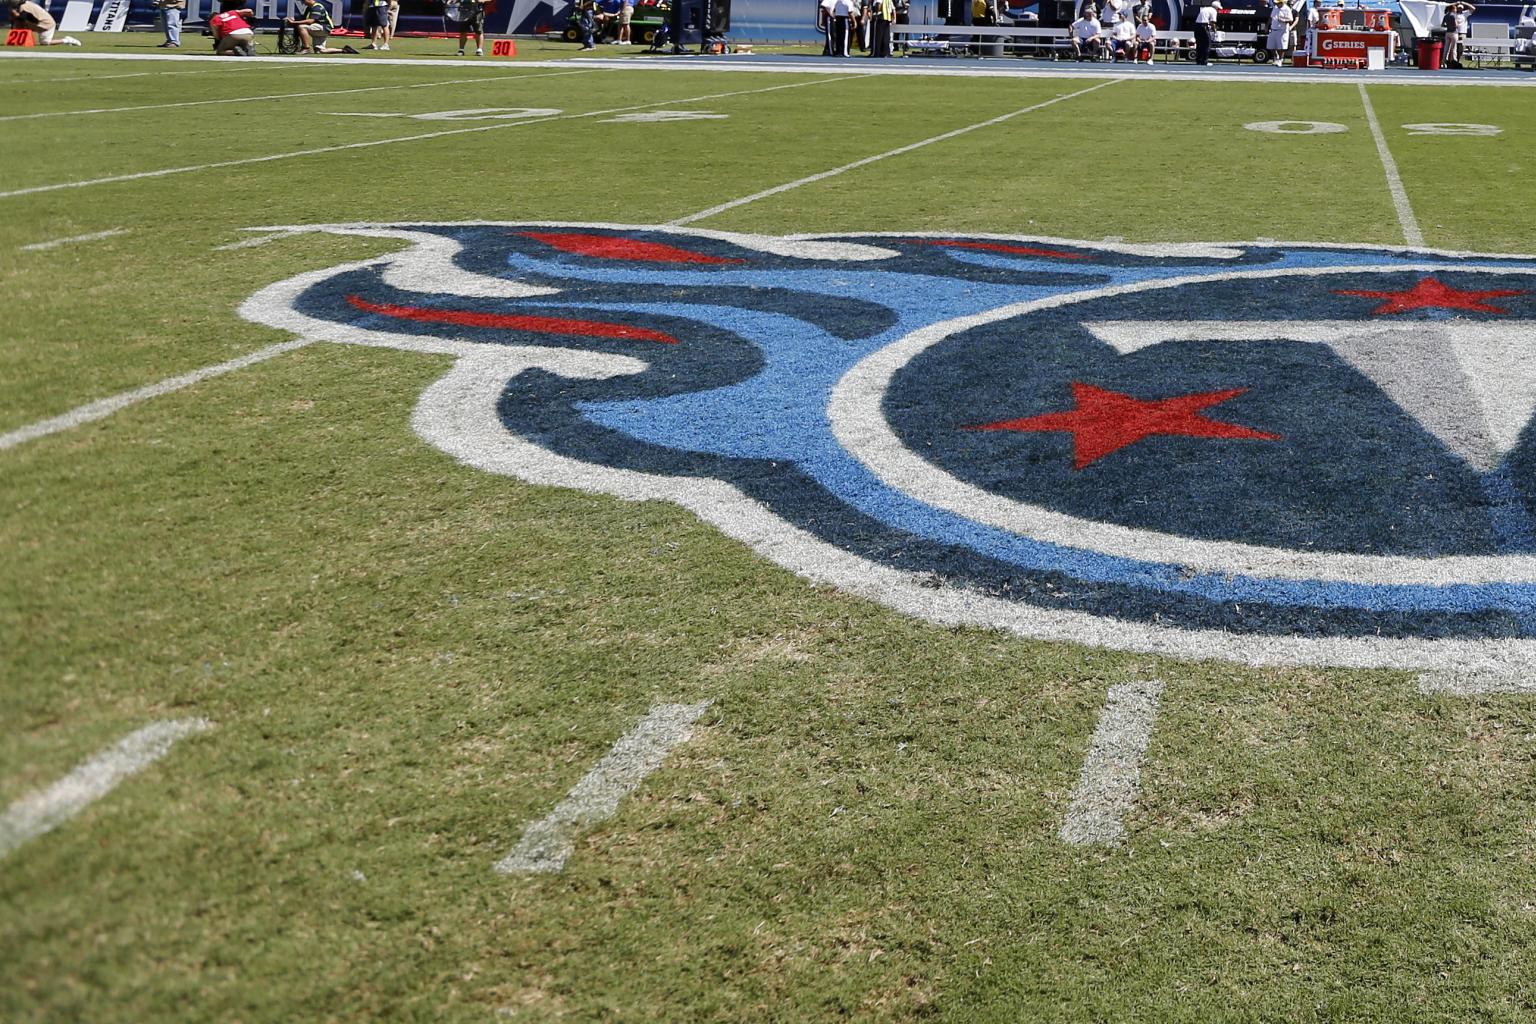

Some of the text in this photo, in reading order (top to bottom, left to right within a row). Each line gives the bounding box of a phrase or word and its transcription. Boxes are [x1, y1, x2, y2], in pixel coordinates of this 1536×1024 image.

[102, 0, 121, 32] TITANS
[8, 31, 27, 45] 20
[1333, 41, 1365, 49] SERIES
[493, 41, 510, 56] 30
